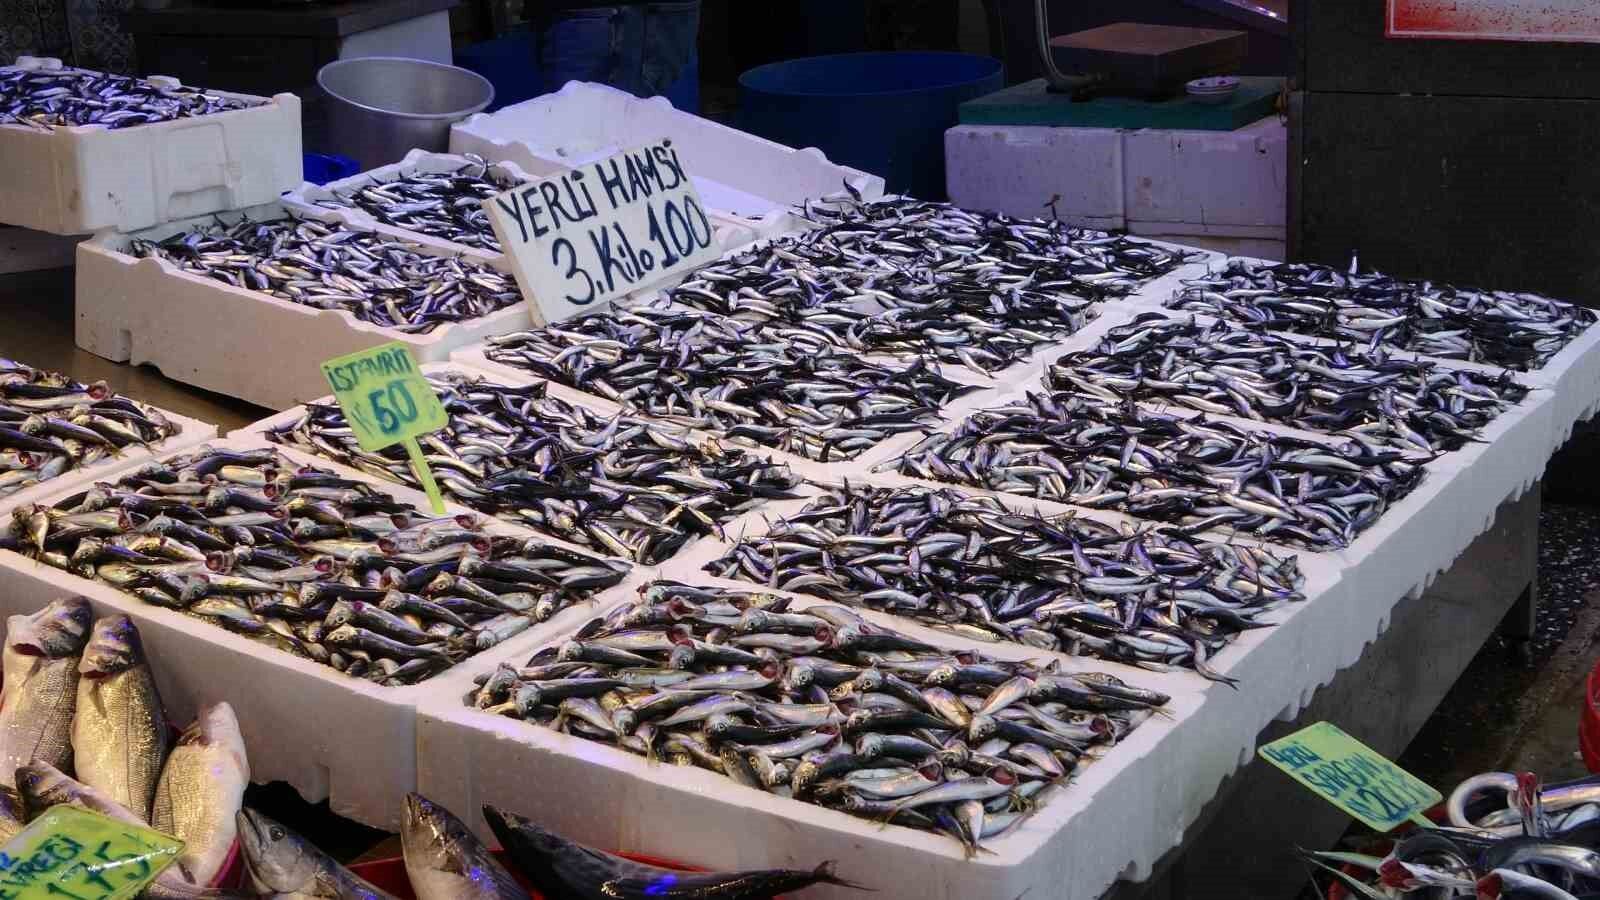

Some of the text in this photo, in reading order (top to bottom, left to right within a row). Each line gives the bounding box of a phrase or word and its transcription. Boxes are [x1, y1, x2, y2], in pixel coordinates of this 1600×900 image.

[495, 139, 688, 243] YERLİ HAMSİ
[646, 195, 711, 269] 100
